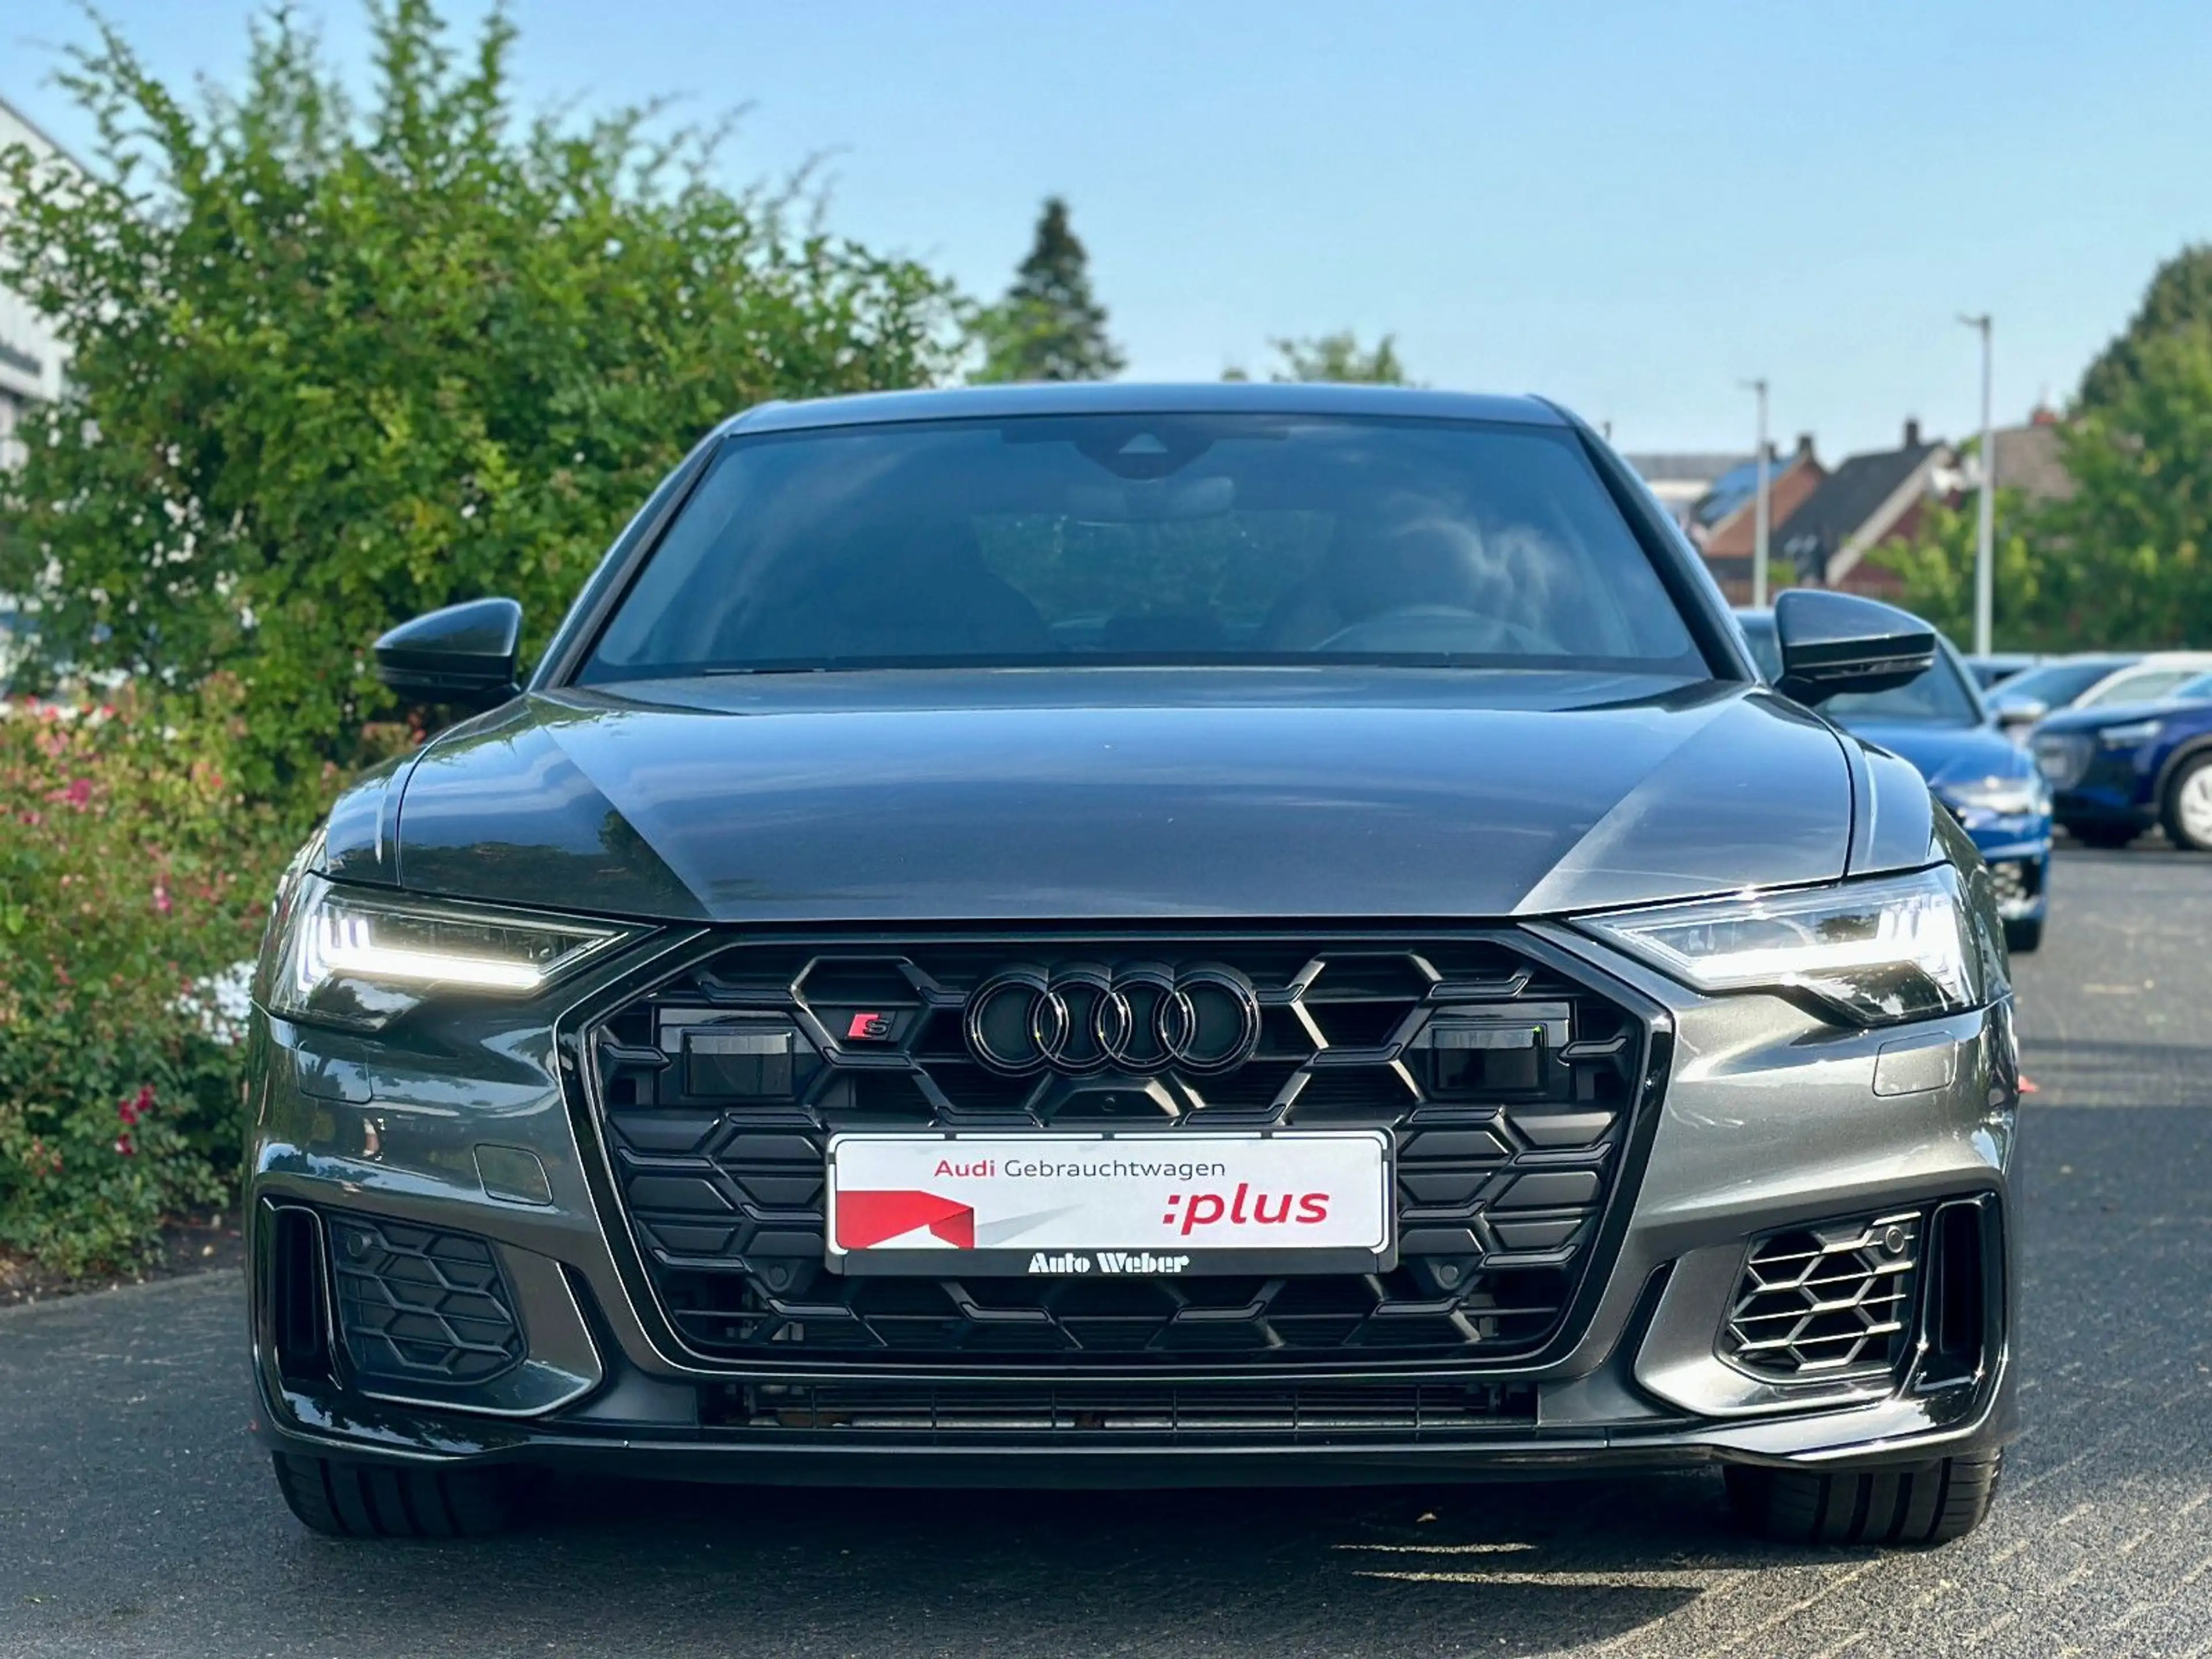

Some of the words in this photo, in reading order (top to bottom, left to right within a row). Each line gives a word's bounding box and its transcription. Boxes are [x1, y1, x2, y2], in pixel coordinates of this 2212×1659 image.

[935, 1160, 995, 1177] Audi
[1004, 1160, 1225, 1180] Gebrauchtwagen
[1028, 1252, 1091, 1273] Auto
[1096, 1252, 1190, 1273] Weber
